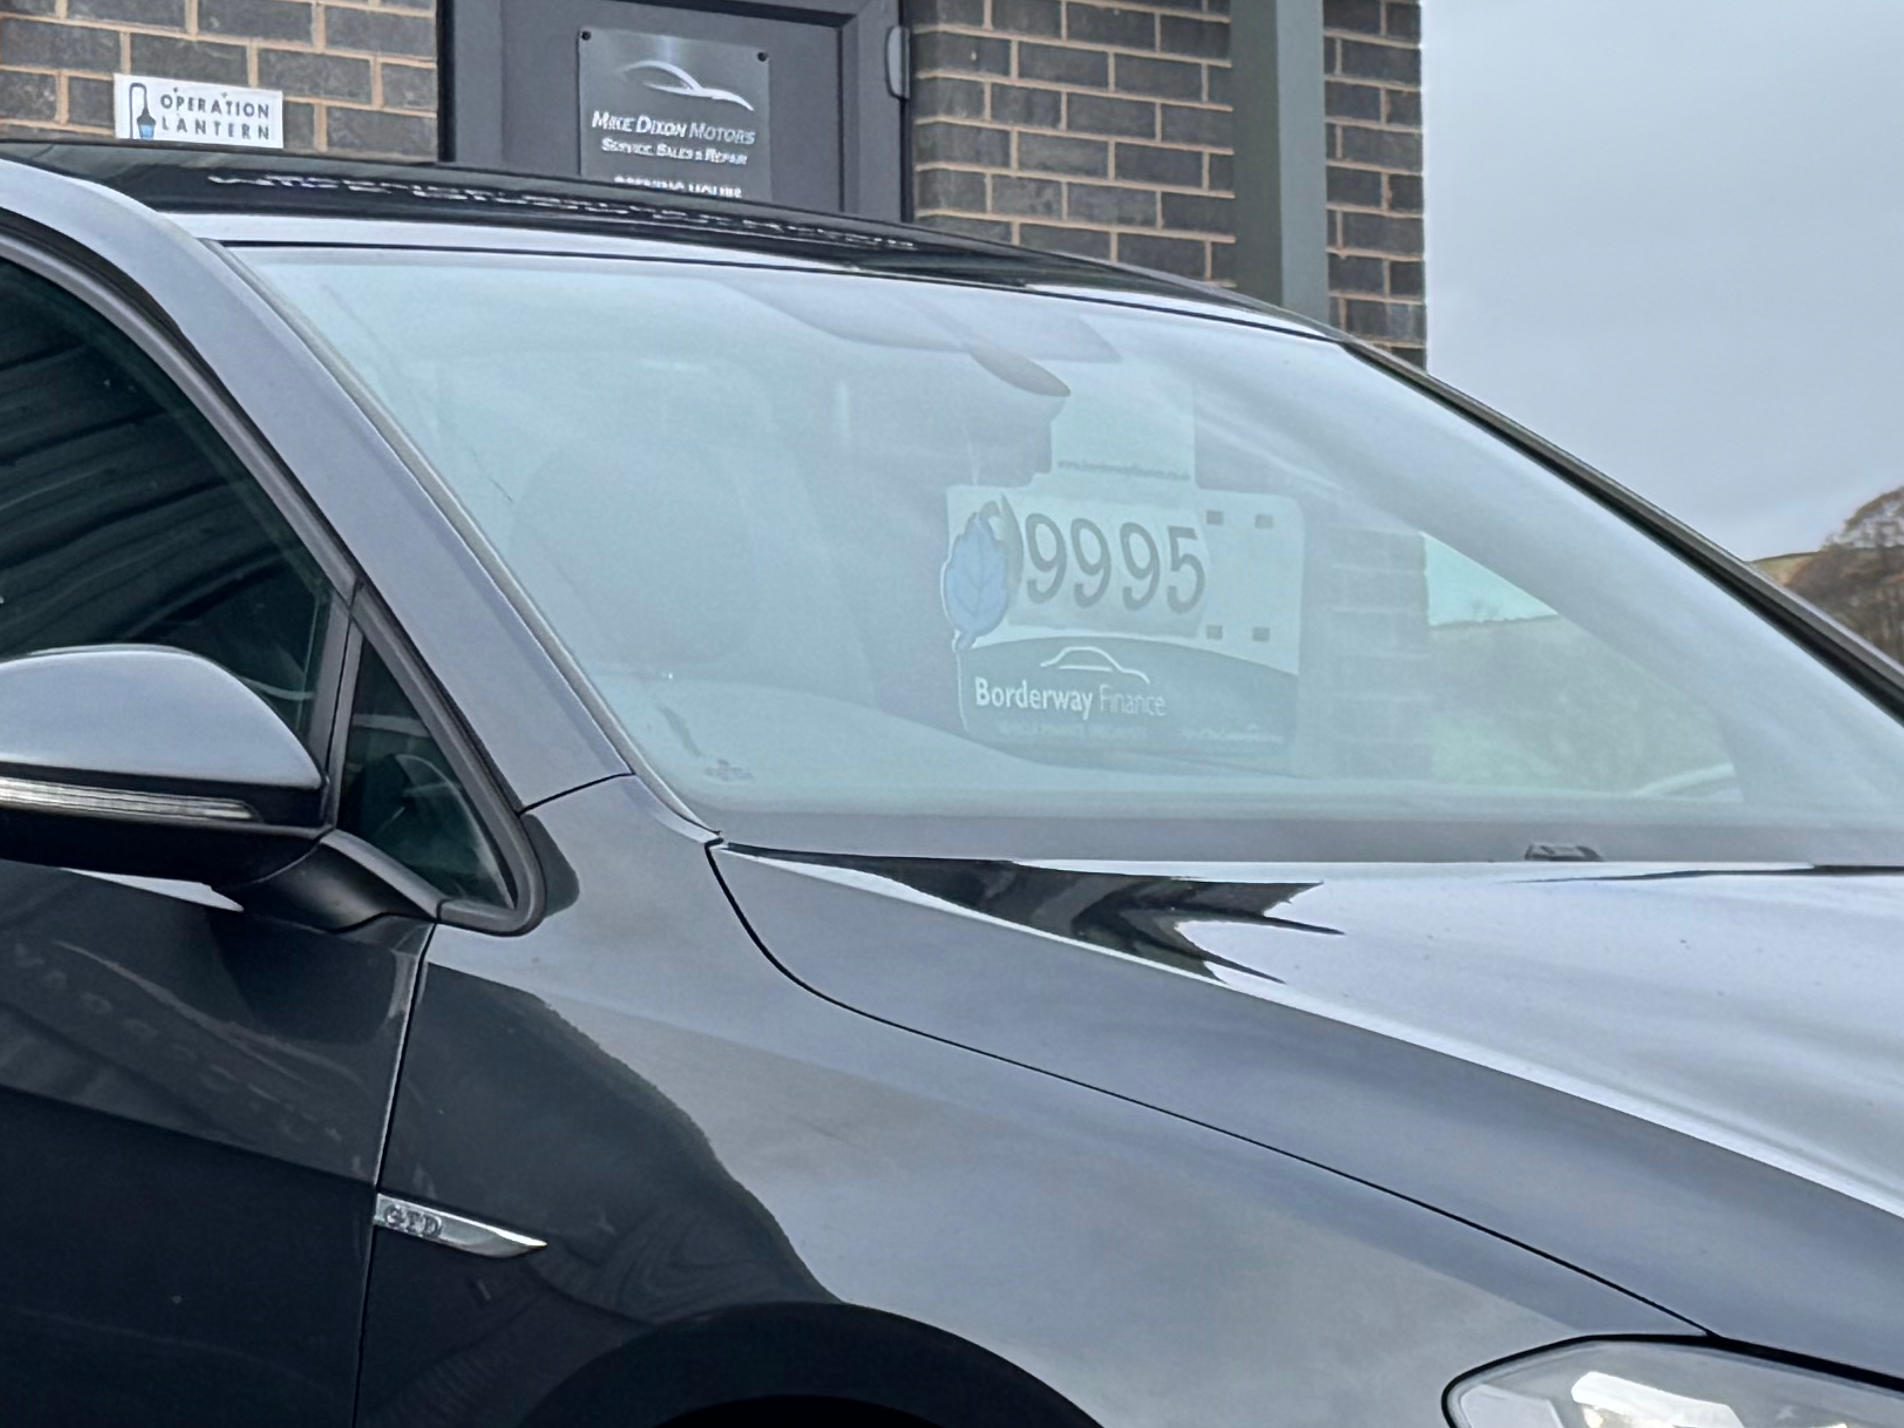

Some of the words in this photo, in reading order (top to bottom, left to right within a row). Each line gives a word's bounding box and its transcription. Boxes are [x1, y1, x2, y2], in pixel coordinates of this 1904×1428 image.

[160, 93, 270, 119] OPERATION
[162, 115, 270, 141] LANTERN
[591, 110, 636, 133] MIKE
[636, 115, 688, 139] DIXON
[688, 119, 756, 145] MOTORS
[975, 677, 1094, 720] Borderway
[1098, 684, 1167, 716] Finance
